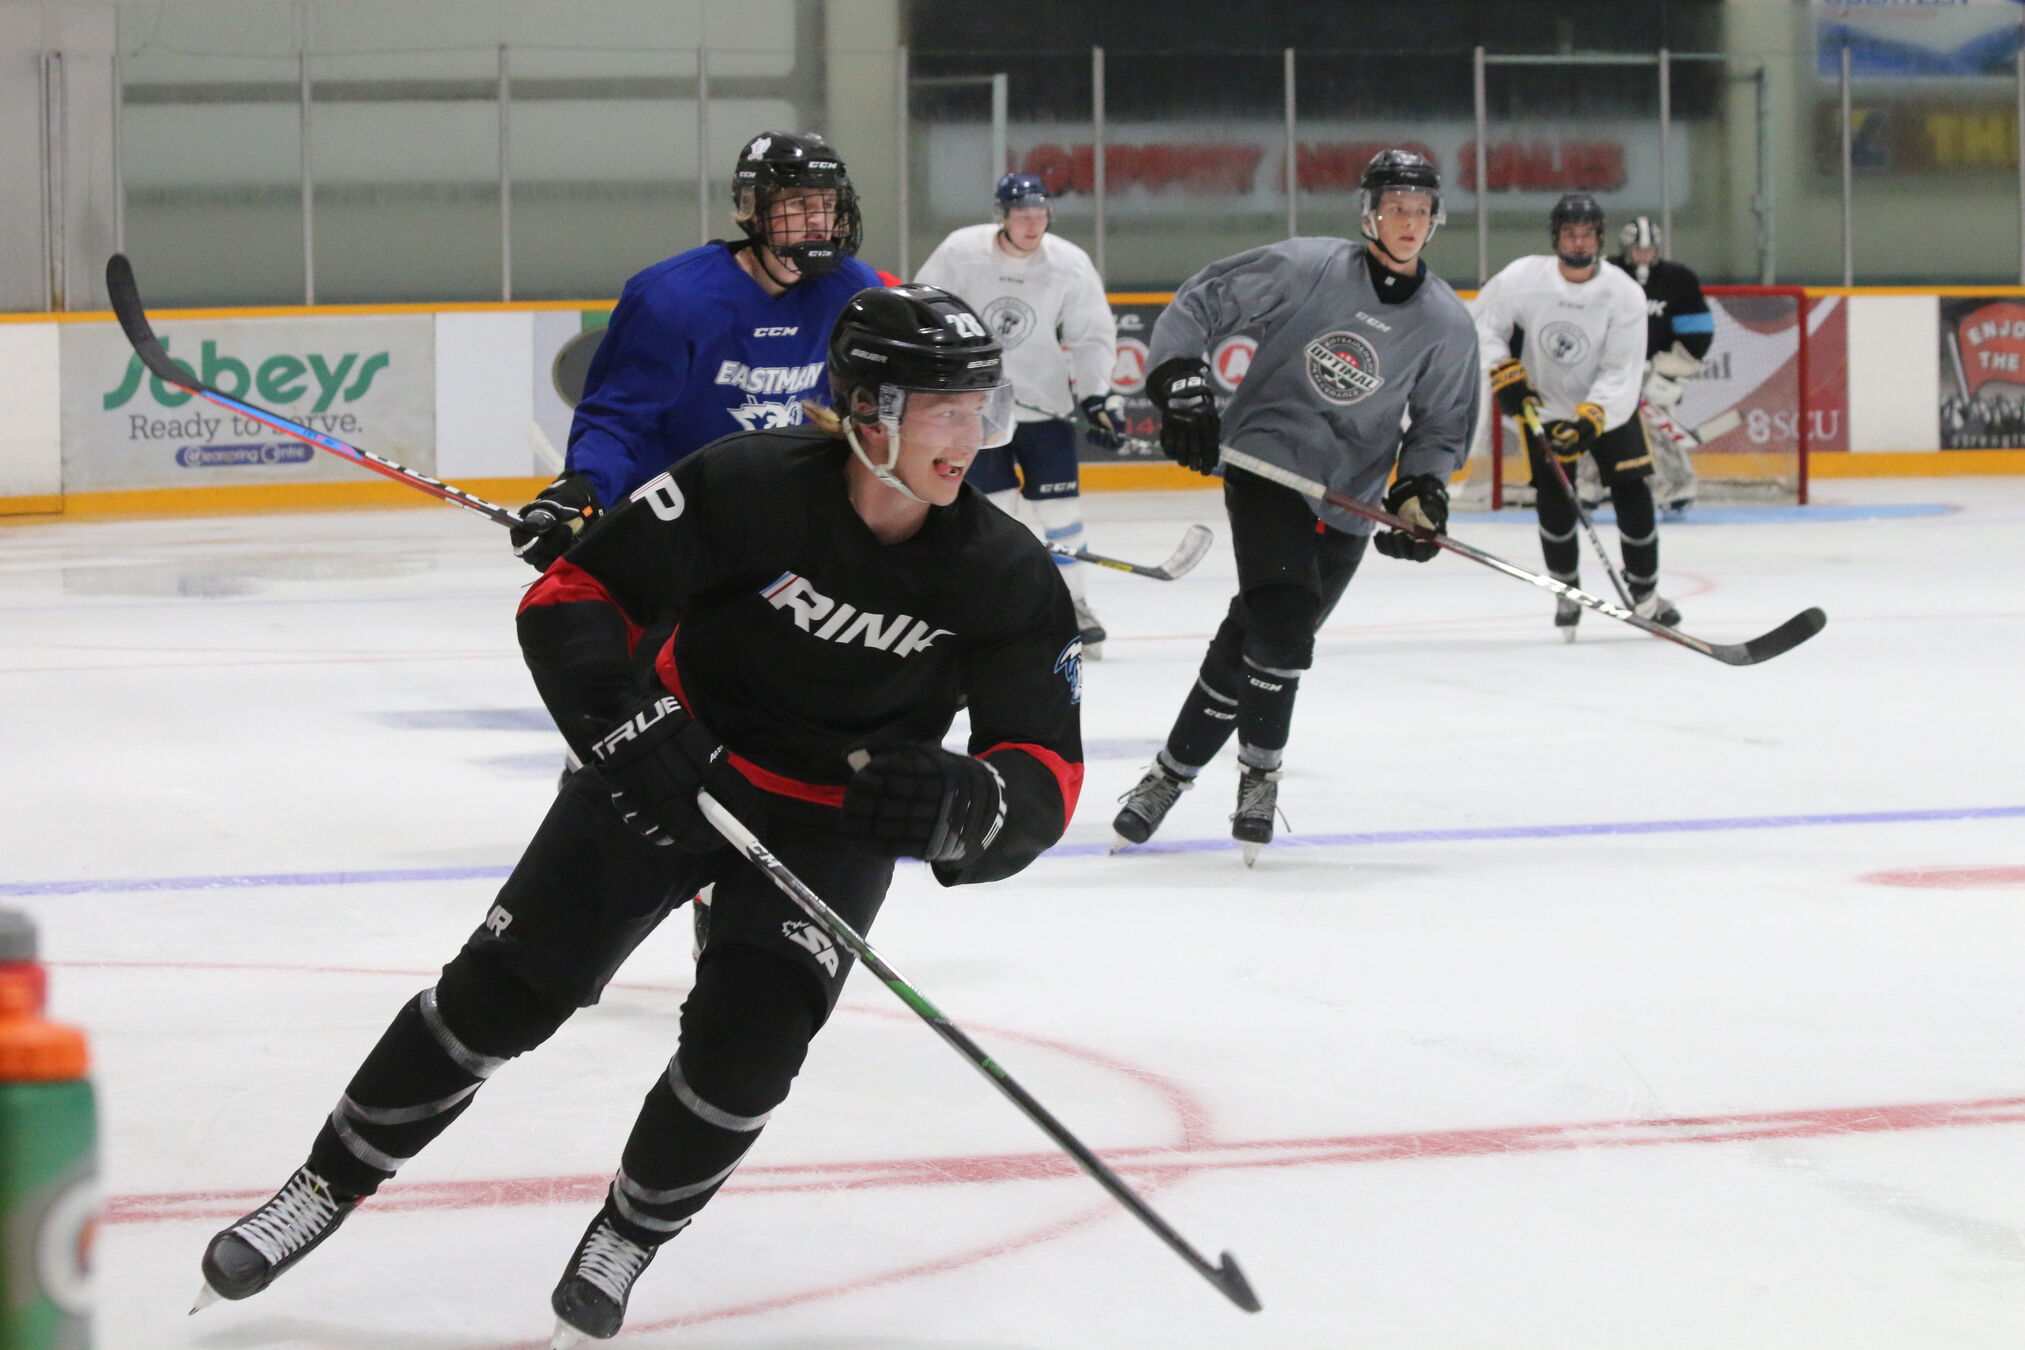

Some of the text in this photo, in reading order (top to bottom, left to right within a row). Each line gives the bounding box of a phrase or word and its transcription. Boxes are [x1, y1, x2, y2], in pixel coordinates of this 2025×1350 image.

[808, 161, 838, 169] CCM
[753, 326, 799, 337] CCM
[945, 312, 986, 339] 28
[1355, 311, 1393, 333] CCM
[1308, 345, 1373, 387] OPTIMAL
[1979, 351, 2020, 371] THE
[103, 336, 390, 414] Sobeys
[714, 360, 825, 395] EASTMAN
[129, 412, 221, 443] Ready
[226, 414, 262, 439] to
[1039, 482, 1077, 493] CCM
[759, 571, 957, 658] RINK
[1250, 678, 1283, 692] CCM
[1203, 708, 1237, 720] CCM
[592, 695, 682, 761] TRUE
